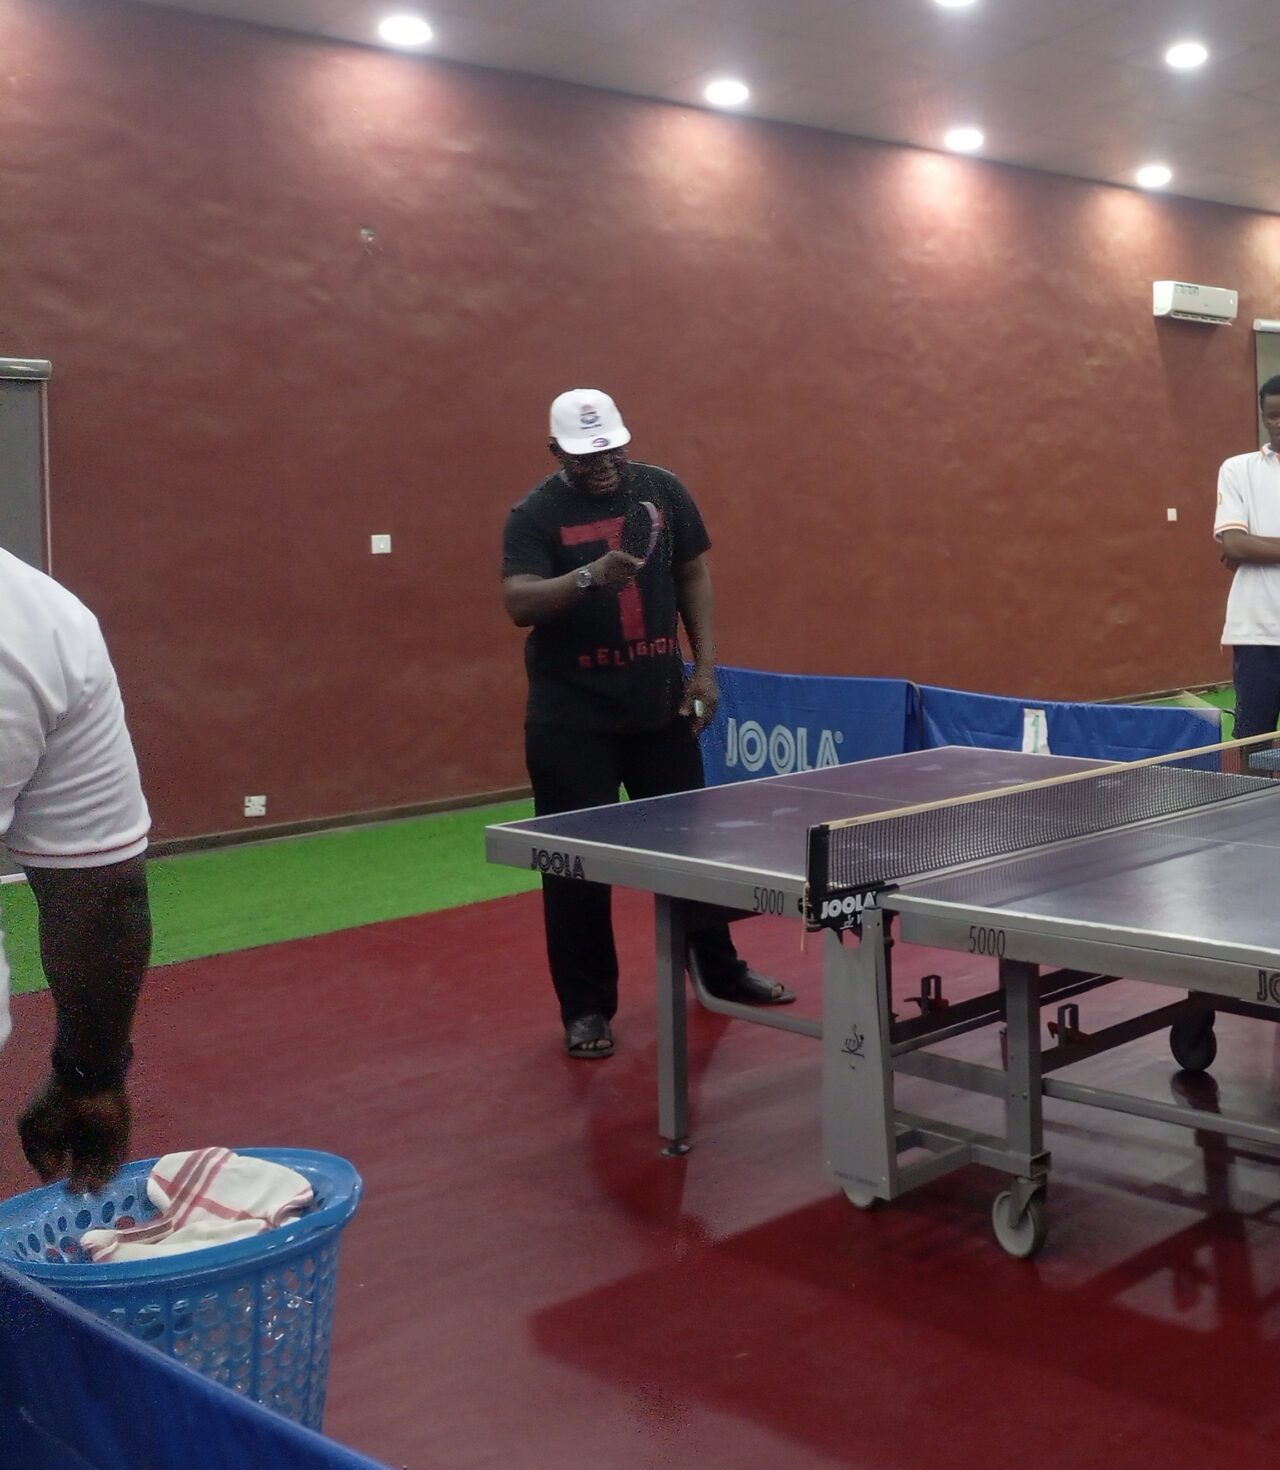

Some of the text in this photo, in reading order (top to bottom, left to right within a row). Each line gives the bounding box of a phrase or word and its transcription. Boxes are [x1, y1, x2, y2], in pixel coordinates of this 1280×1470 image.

[531, 847, 585, 880] JOOLA
[753, 886, 784, 915] 5000
[821, 891, 876, 919] JOOLA
[968, 925, 1005, 957] 5000
